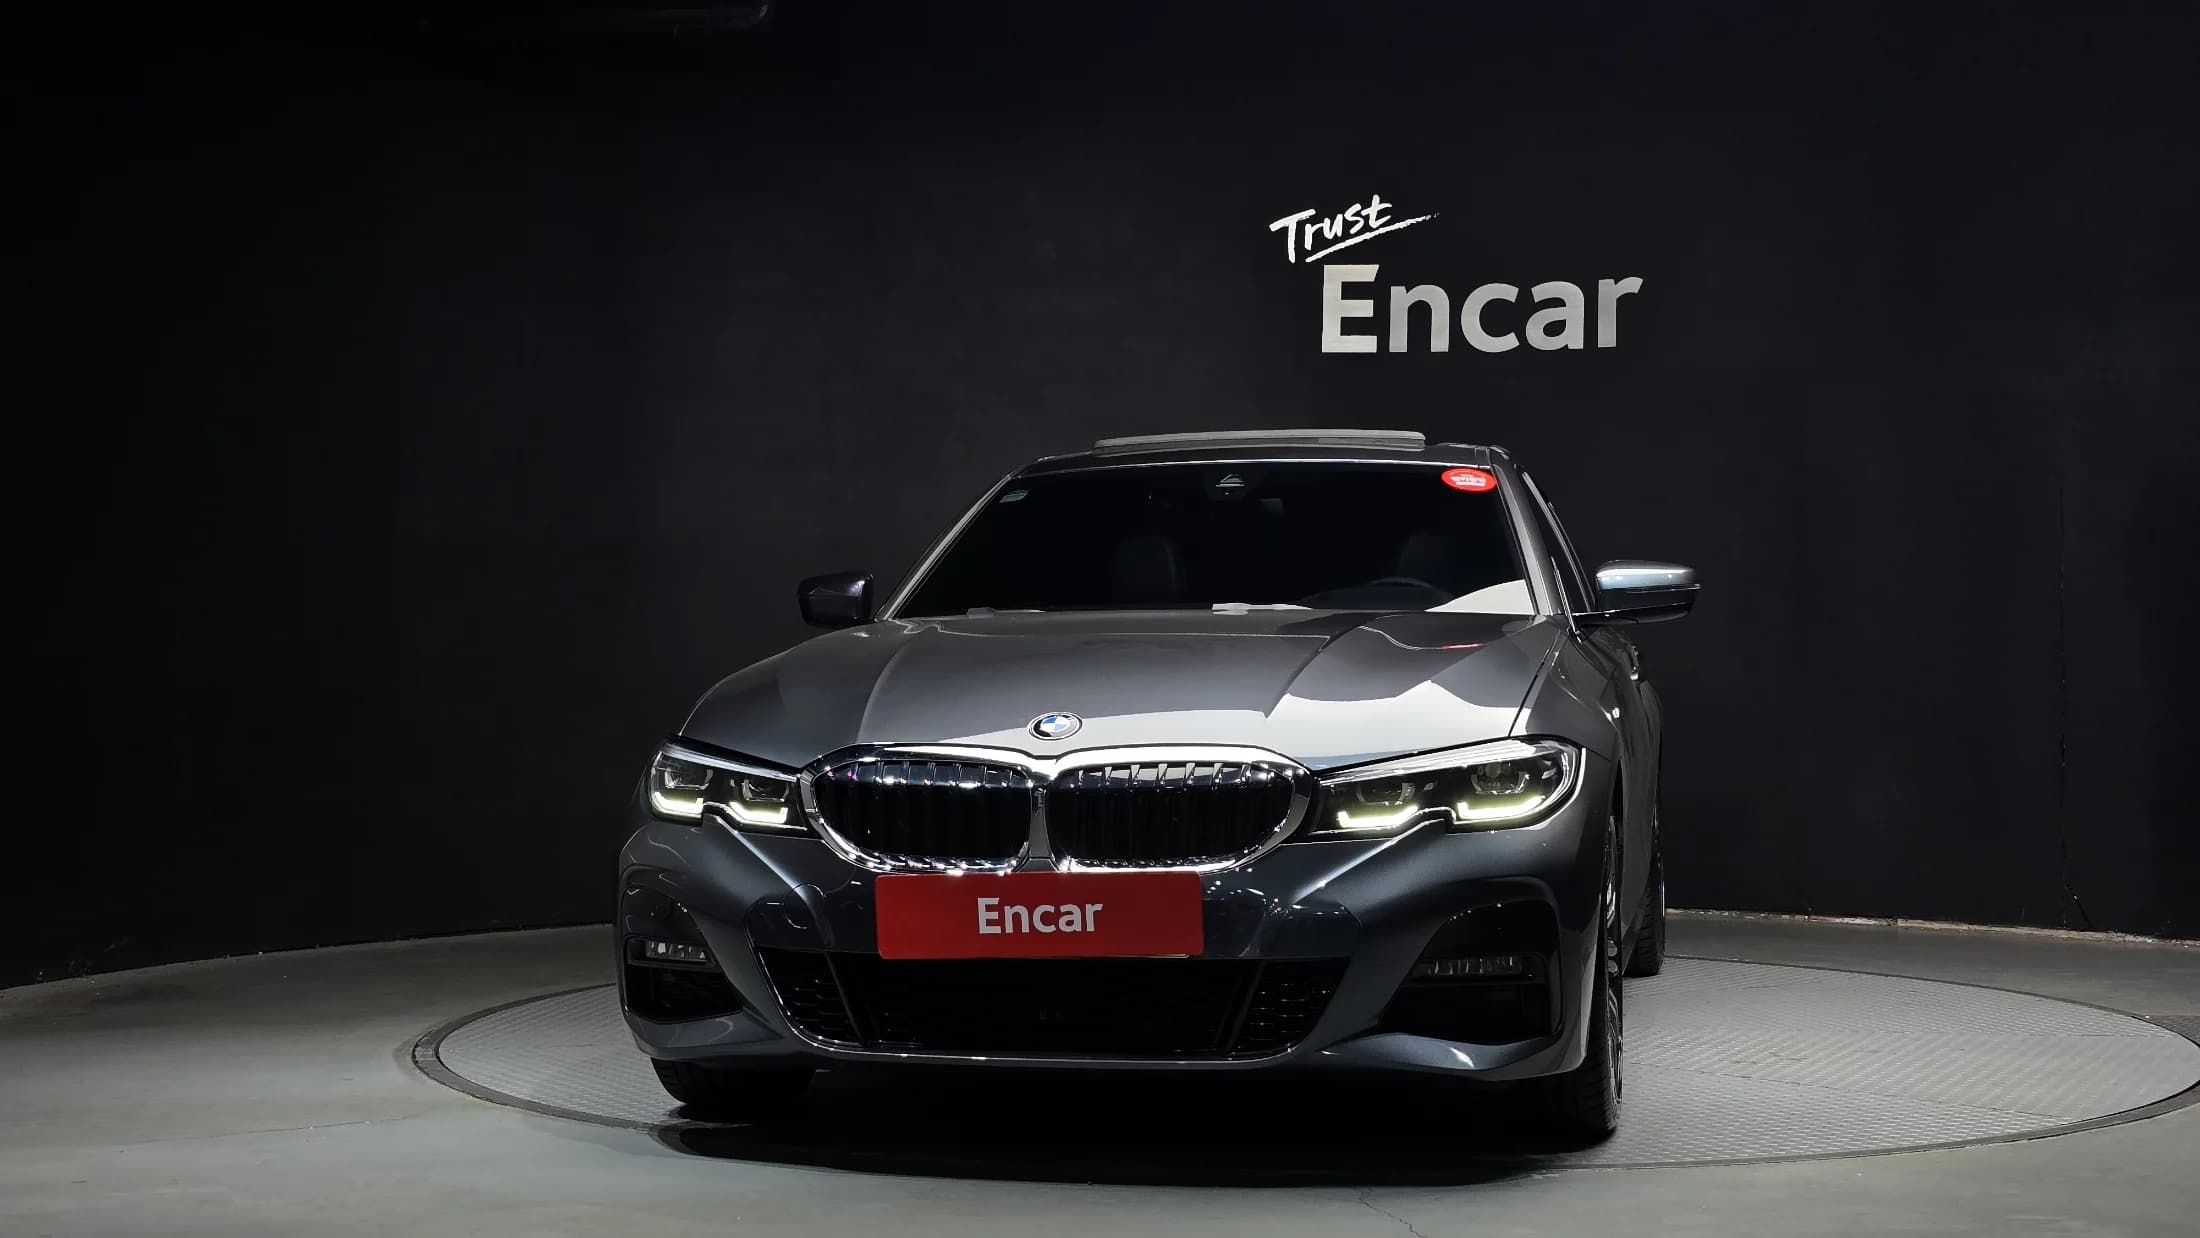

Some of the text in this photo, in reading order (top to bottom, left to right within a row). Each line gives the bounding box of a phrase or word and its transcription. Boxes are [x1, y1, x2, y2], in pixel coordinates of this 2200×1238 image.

[1269, 194, 1393, 263] Trust
[1322, 264, 1643, 353] Encar
[977, 897, 1103, 934] Encar
